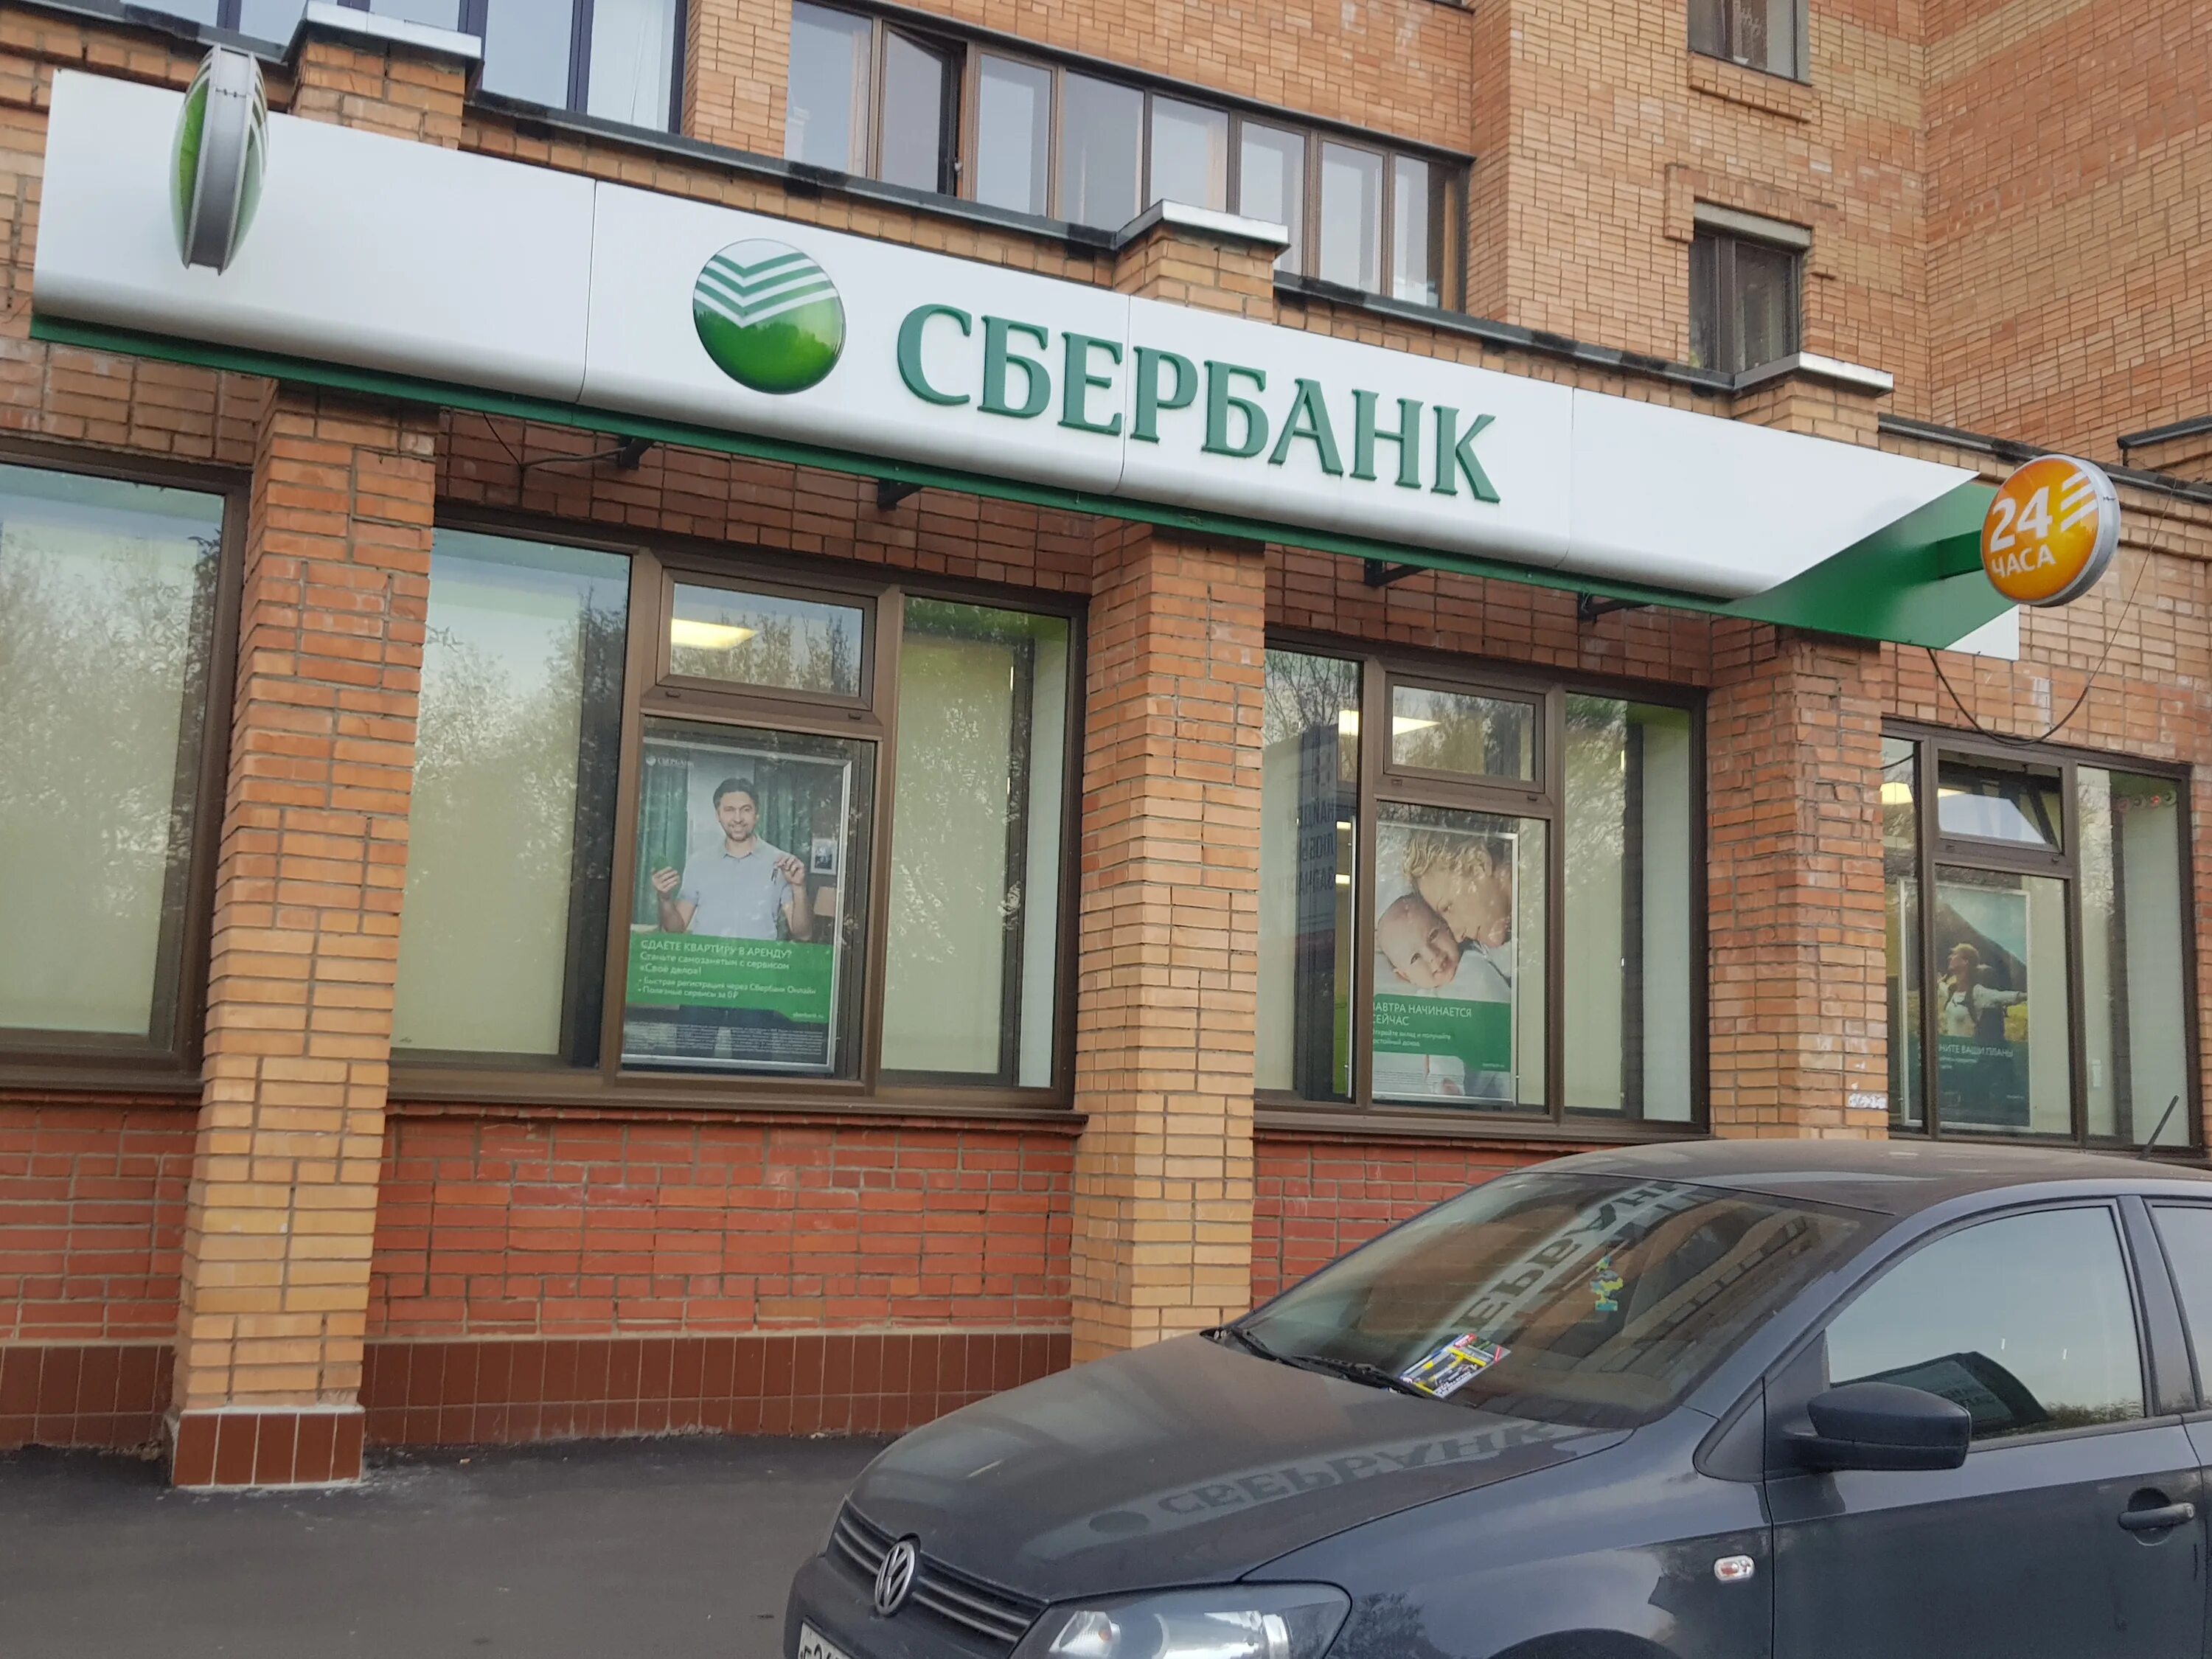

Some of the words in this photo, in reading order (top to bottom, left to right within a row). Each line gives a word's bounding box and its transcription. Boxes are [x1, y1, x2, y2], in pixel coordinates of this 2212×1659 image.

[897, 303, 1501, 504] СБЕРБАНК
[1990, 486, 2053, 553] 24
[1992, 544, 2056, 578] ЧАСА
[684, 942, 737, 955] КВАРТИРУ
[739, 947, 745, 956] В
[747, 947, 793, 959] АРЕНДУ?
[678, 956, 738, 967] самозанятым
[746, 961, 790, 970] сервисом
[1373, 1002, 1406, 1013] АВТРА
[1408, 1005, 1472, 1018] НАЧИНАЕТСЯ
[1373, 1029, 1399, 1037] ткройте
